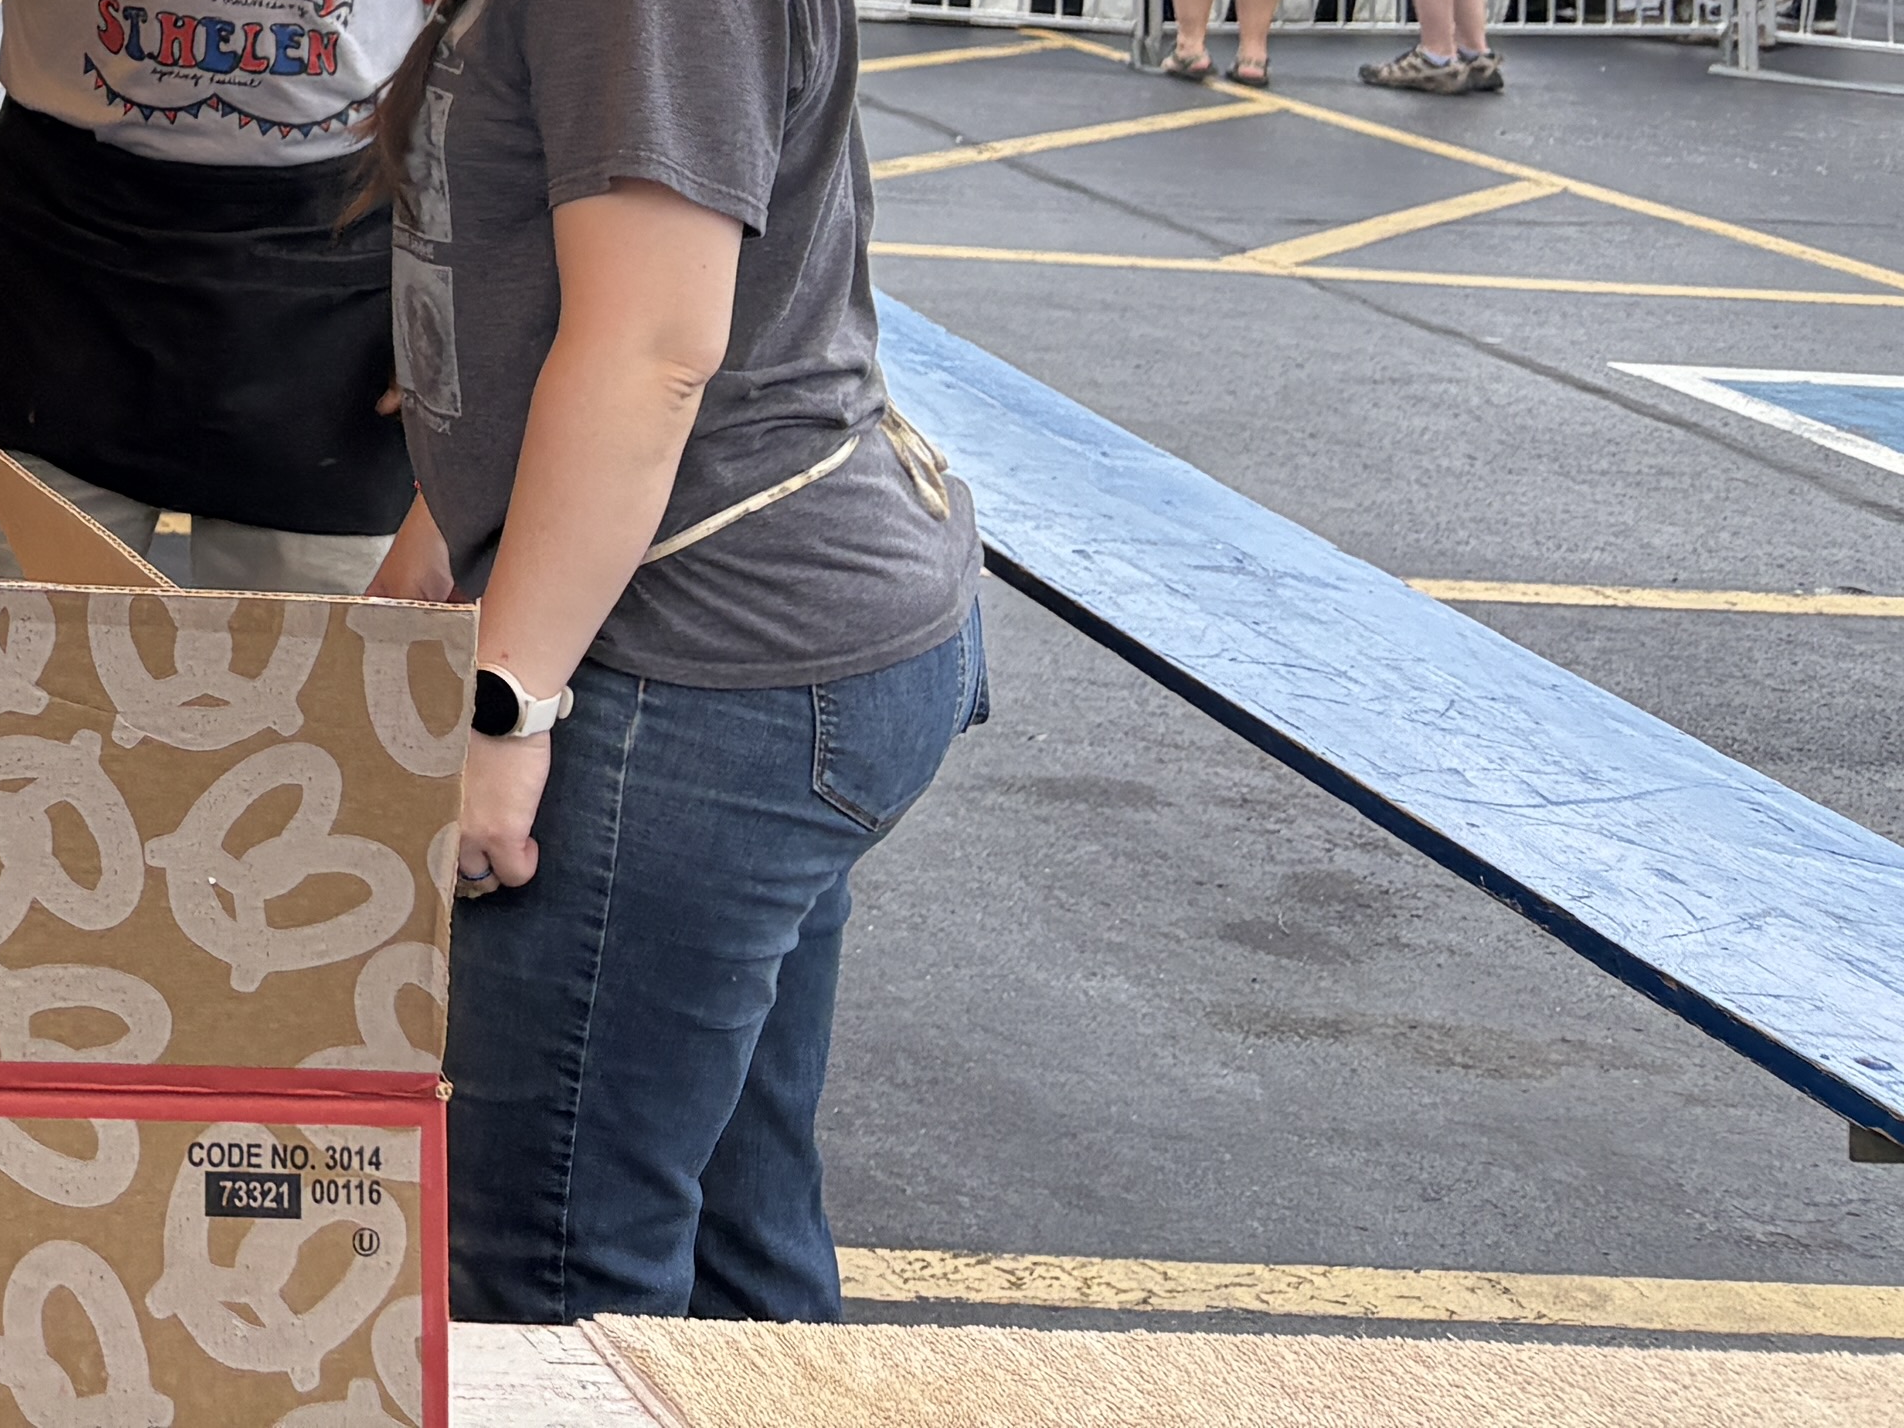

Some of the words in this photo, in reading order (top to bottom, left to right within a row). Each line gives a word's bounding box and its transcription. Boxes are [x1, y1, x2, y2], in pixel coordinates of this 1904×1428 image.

[187, 1142, 262, 1168] CODE
[271, 1143, 316, 1170] NO.
[324, 1145, 382, 1171] 3014
[219, 1181, 290, 1208] 73321
[311, 1179, 382, 1205] 00116
